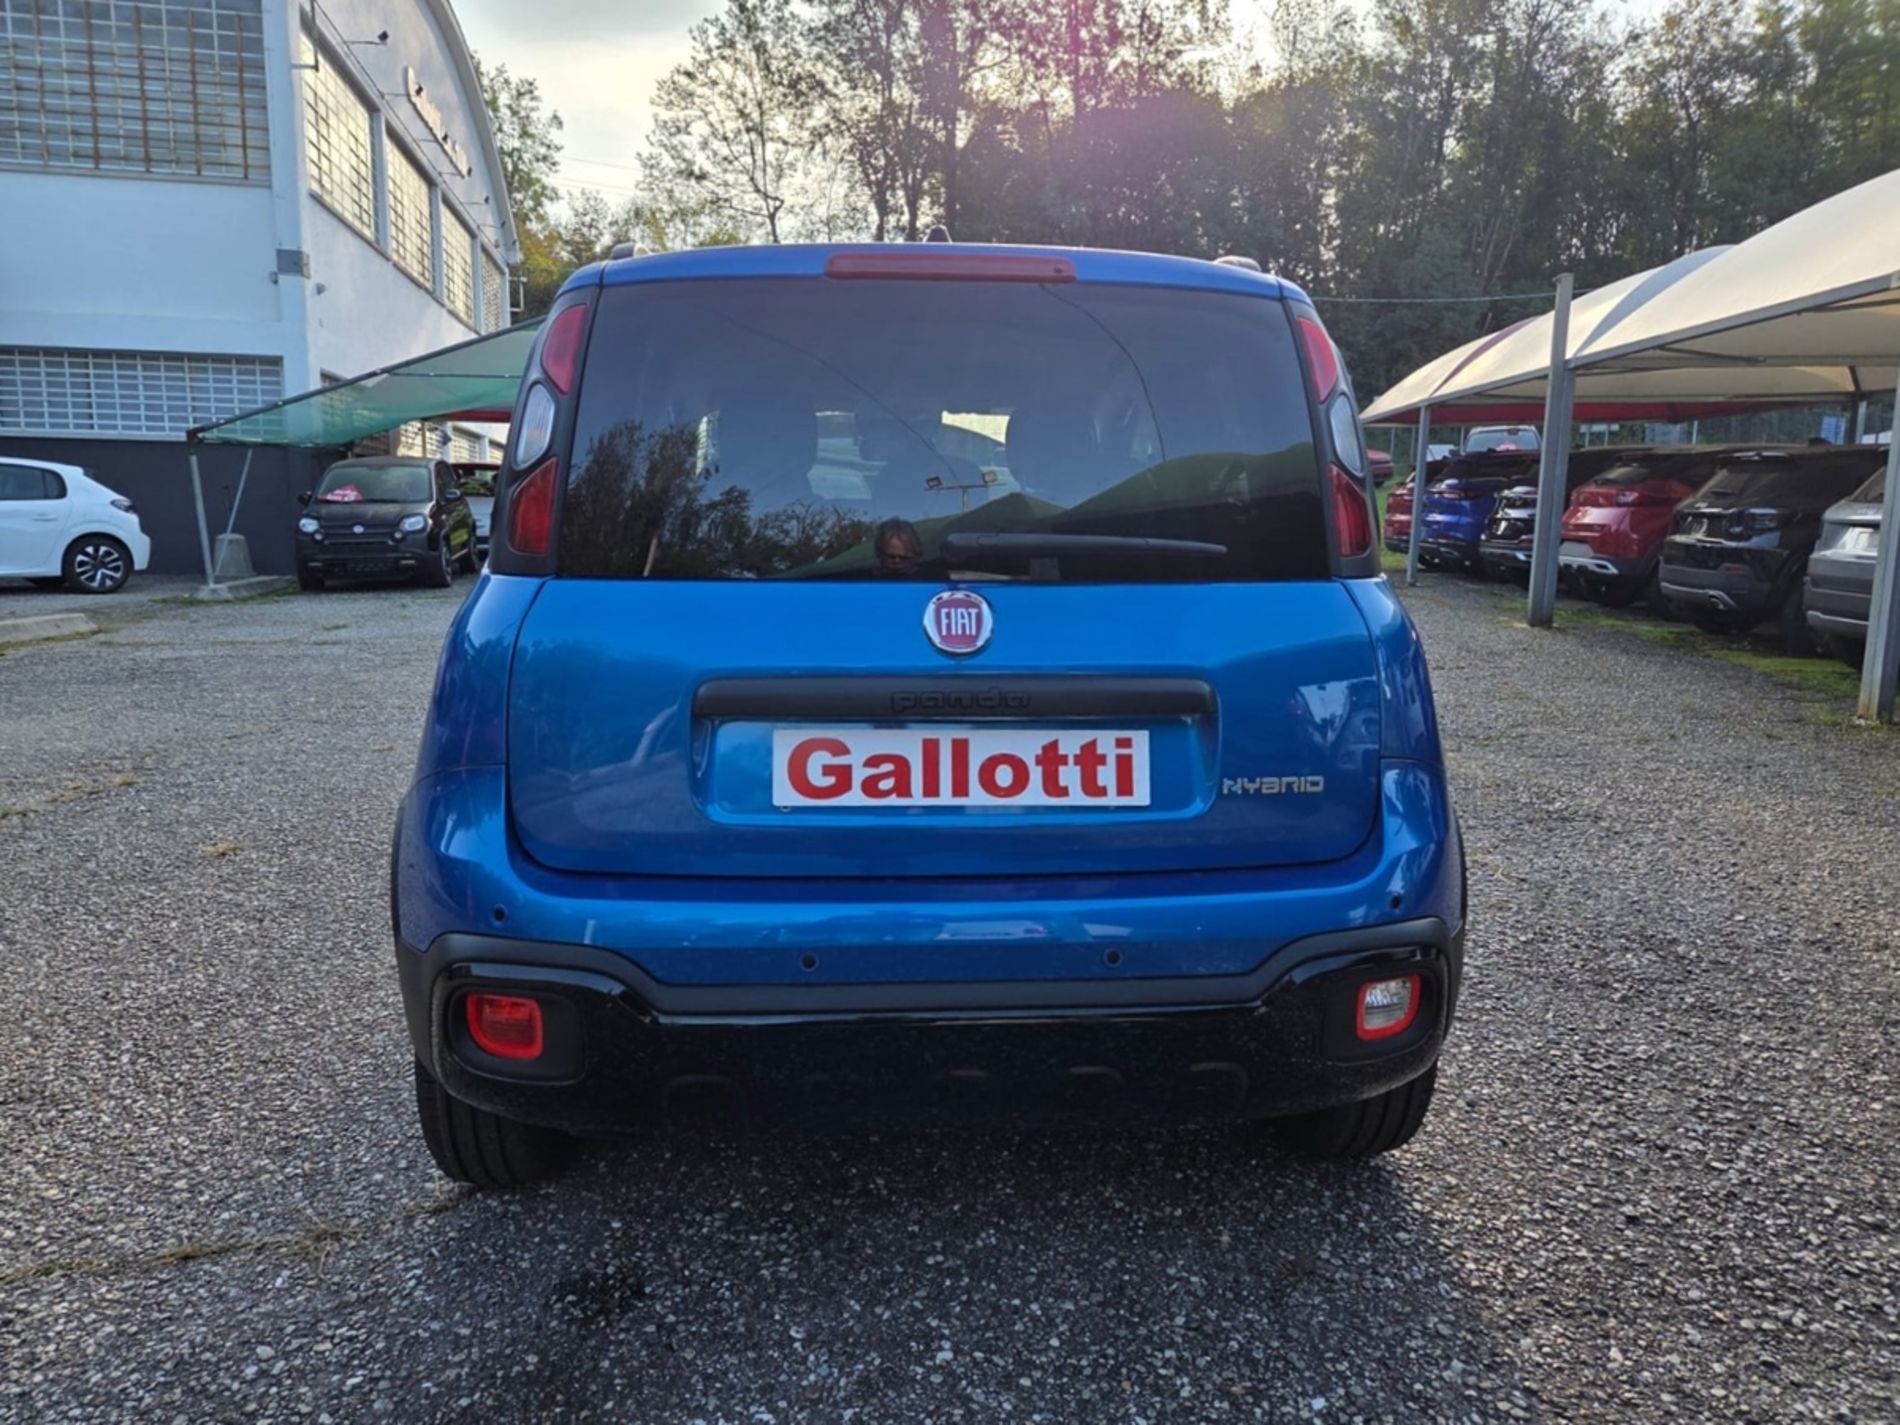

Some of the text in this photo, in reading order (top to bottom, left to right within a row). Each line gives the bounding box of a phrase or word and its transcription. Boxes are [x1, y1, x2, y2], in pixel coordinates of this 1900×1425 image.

[940, 607, 979, 636] FIAT
[891, 687, 1031, 713] panda
[786, 736, 1135, 800] Gallotti
[1222, 775, 1325, 795] HYBRID
